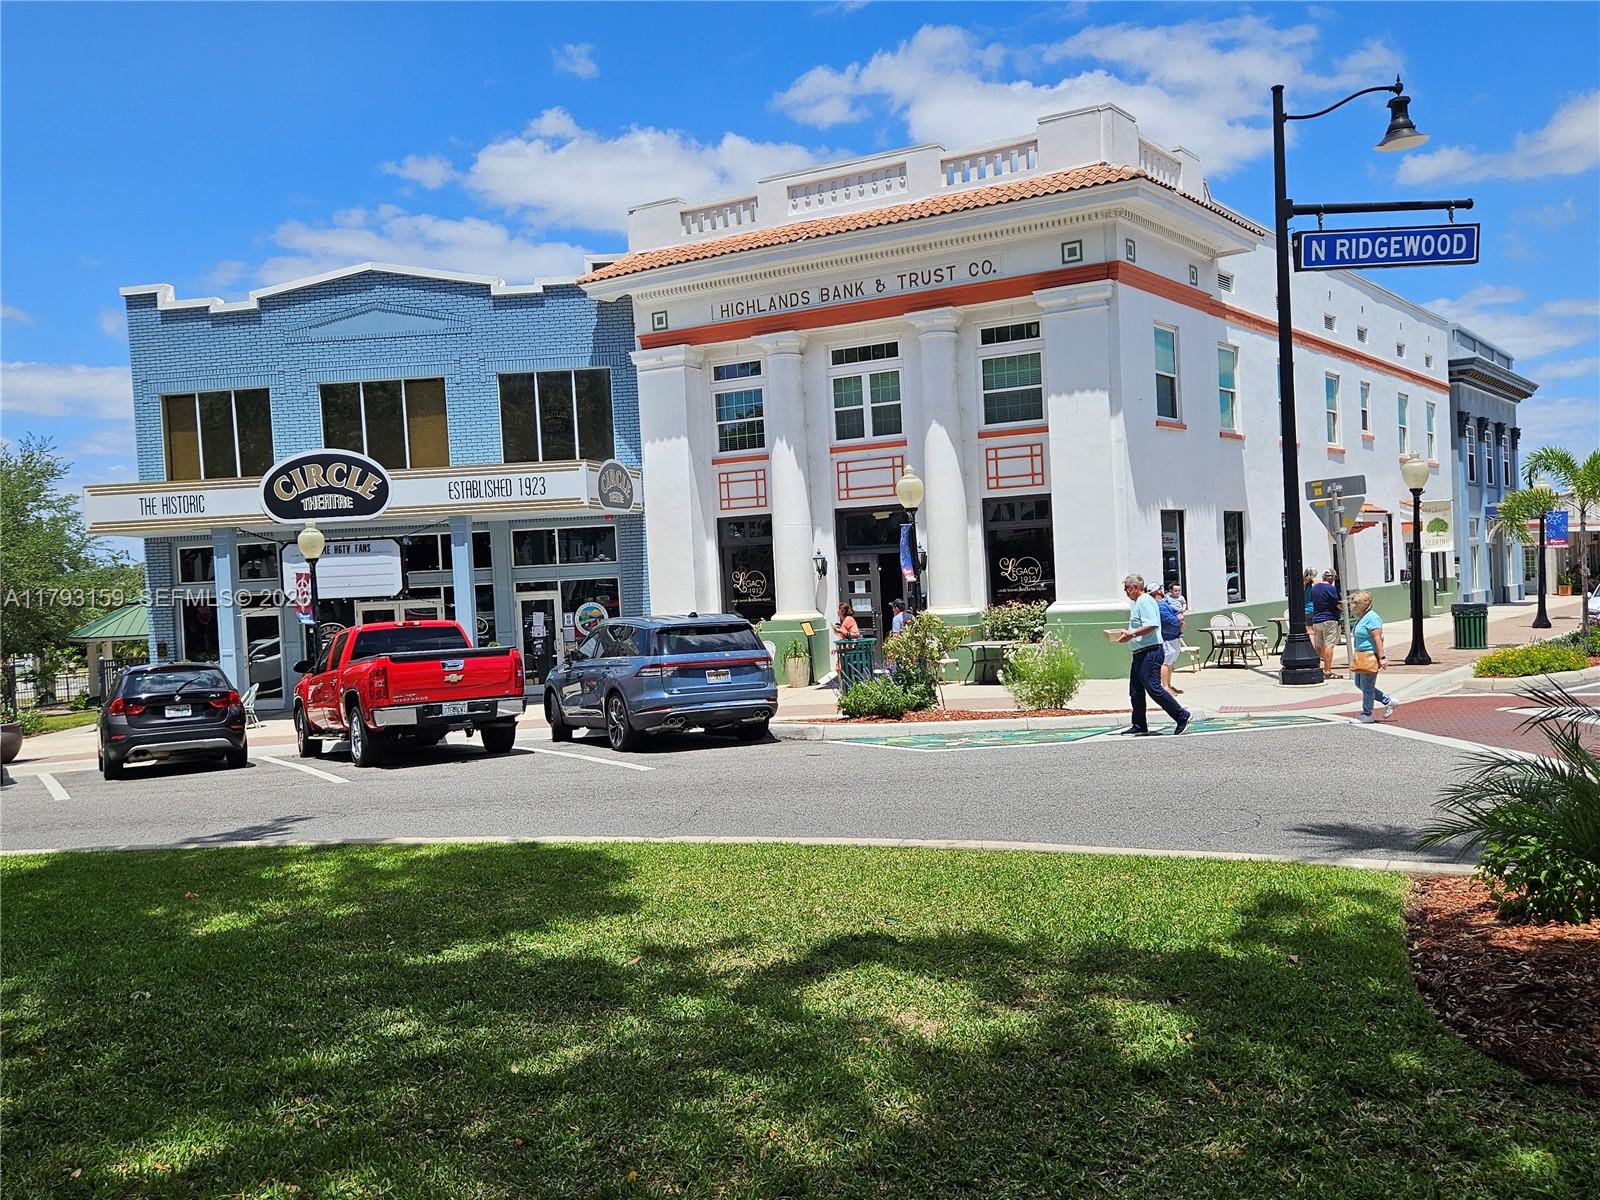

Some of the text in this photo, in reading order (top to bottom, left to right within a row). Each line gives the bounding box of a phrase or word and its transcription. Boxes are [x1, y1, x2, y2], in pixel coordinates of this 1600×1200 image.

[1311, 233, 1467, 262] N RIDGEWOOD
[720, 259, 998, 319] HIGHLANDS BANK & TRUST CO.
[272, 461, 383, 502] CIRCLE
[448, 476, 547, 500] ESTABLISHED 1923
[138, 494, 206, 516] THE HISTORIC
[301, 493, 354, 511] THEATRE
[354, 543, 372, 553] FANS
